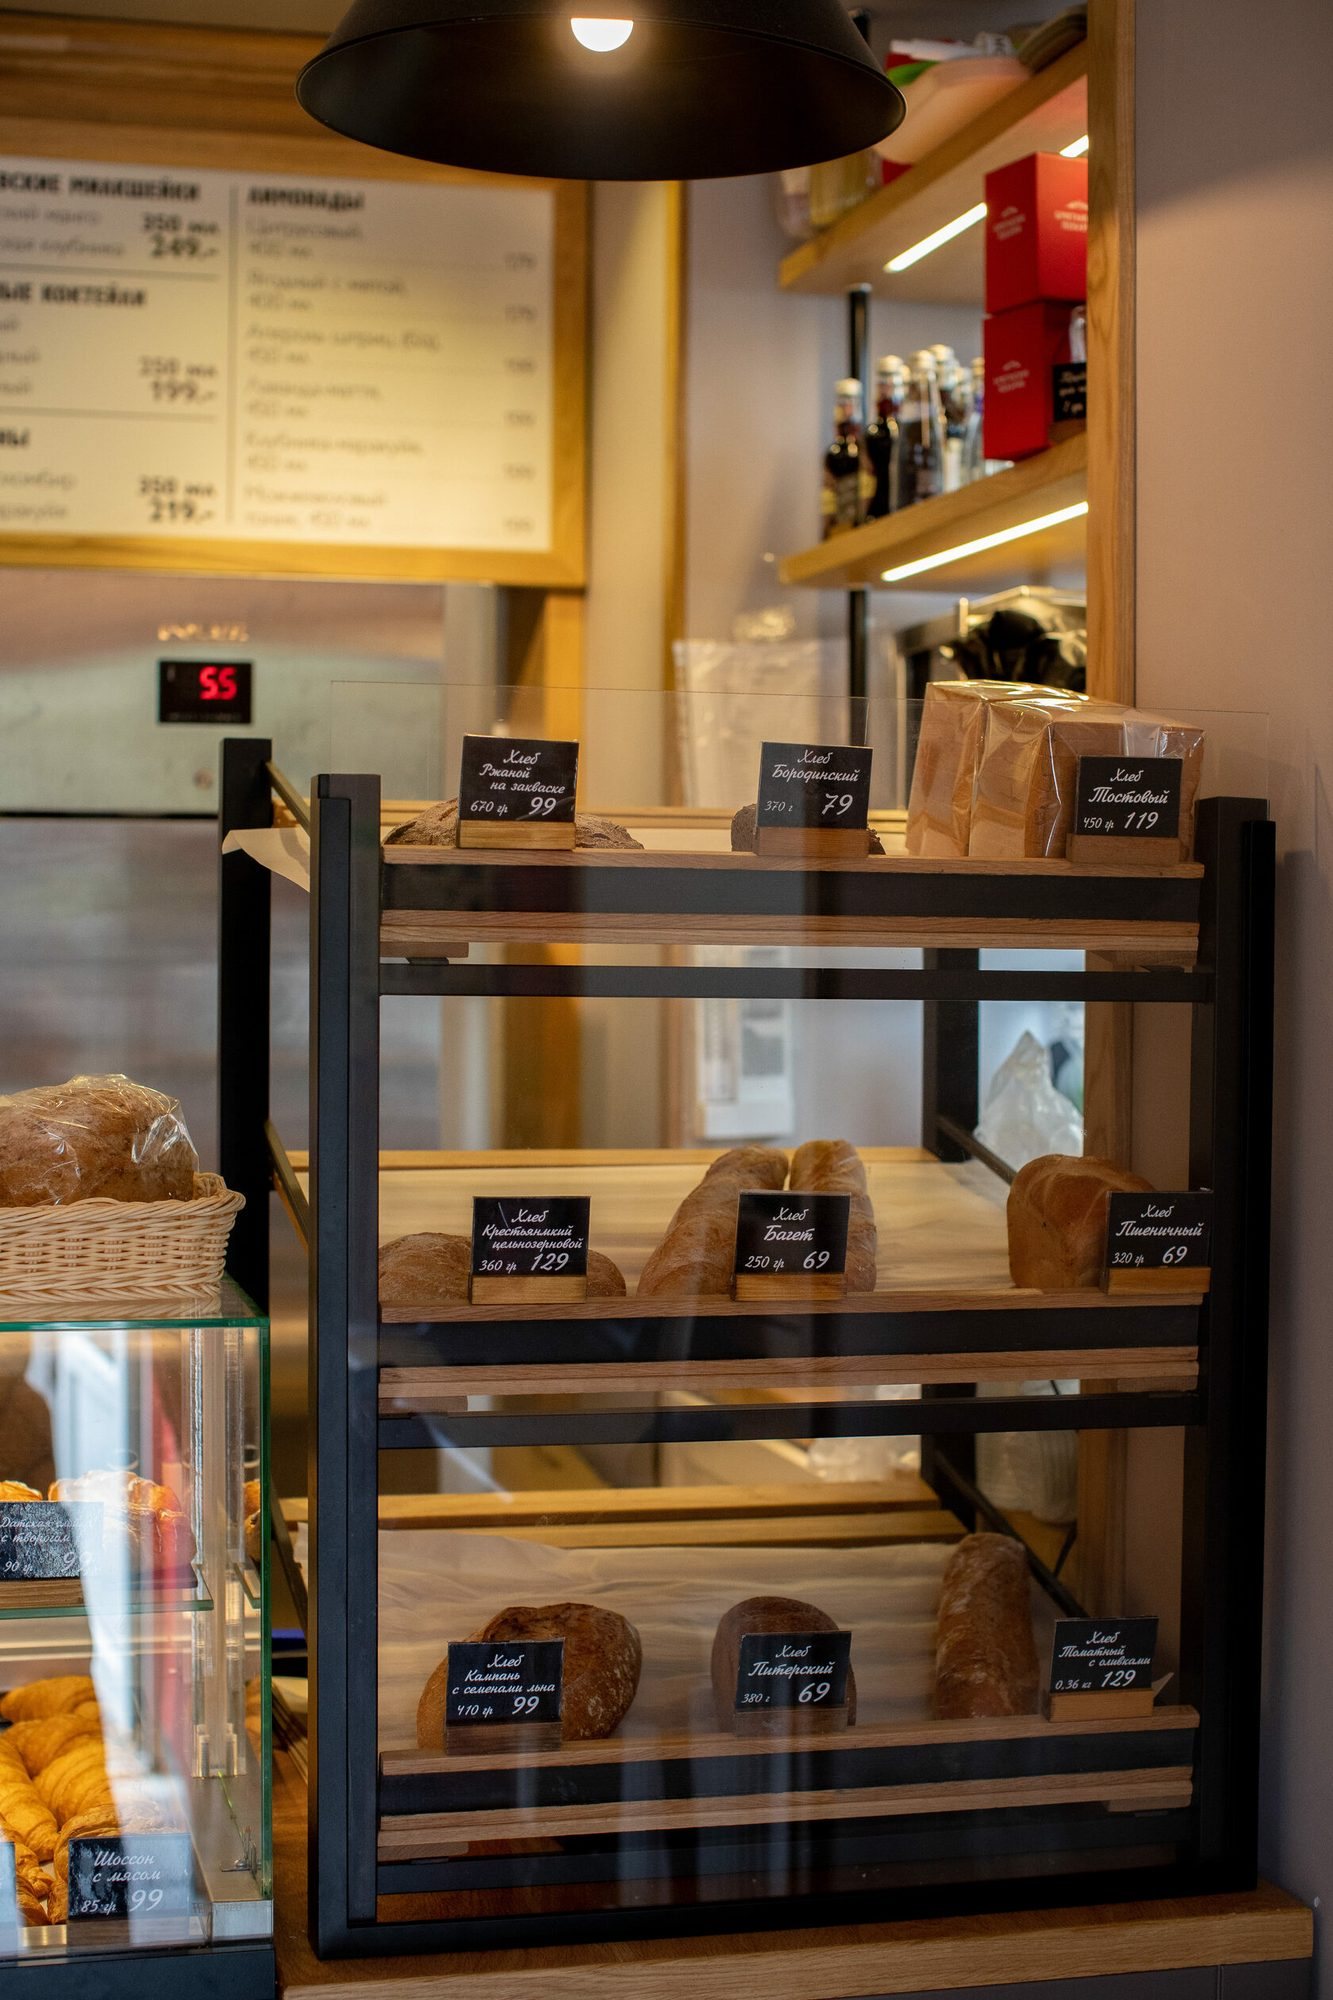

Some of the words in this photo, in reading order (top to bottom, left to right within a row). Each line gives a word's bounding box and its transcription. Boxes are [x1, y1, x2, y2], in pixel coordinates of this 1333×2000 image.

[503, 749, 541, 764] Хлеб
[797, 749, 834, 764] Хлеб
[479, 763, 532, 779] Ржаной
[772, 764, 860, 783] Бородинский
[1110, 768, 1144, 782] Хлеб
[490, 782, 506, 790] на
[510, 782, 565, 793] закваске
[1088, 786, 1170, 804] Тостовый
[470, 800, 494, 812] 670
[497, 804, 508, 817] гр
[528, 796, 557, 816] 99
[764, 800, 786, 812] 370
[821, 793, 853, 816] 79
[1083, 817, 1102, 829] 450
[1104, 820, 1114, 833] гр
[1124, 811, 1159, 830] 119
[511, 1208, 549, 1223] Хлеб
[772, 1207, 809, 1221] Хлеб
[1140, 1204, 1175, 1218] Хлеб
[763, 1224, 815, 1241] Багет
[1115, 1220, 1205, 1236] Пшеничный
[492, 1238, 584, 1252] цельнозерновой
[479, 1259, 503, 1271] 360
[505, 1262, 517, 1274] гр
[530, 1252, 569, 1271] 129
[745, 1255, 770, 1268] 250
[773, 1258, 785, 1272] гр
[803, 1250, 830, 1269] 69
[1111, 1252, 1132, 1264] 320
[1134, 1255, 1145, 1267] гр
[1162, 1246, 1188, 1264] 69
[4, 1560, 20, 1572] 90
[1086, 1631, 1121, 1645] Хлеб
[775, 1644, 812, 1658] Хлеб
[1058, 1645, 1127, 1658] Томатный
[487, 1653, 525, 1668] Хлеб
[1088, 1659, 1096, 1667] с
[1098, 1655, 1151, 1666] оливками
[464, 1669, 521, 1682] Кампань
[747, 1661, 836, 1680] Питерский
[1082, 1681, 1092, 1689] кг
[1101, 1669, 1137, 1688] 129
[452, 1687, 460, 1695] с
[463, 1684, 523, 1694] семенами
[526, 1683, 555, 1692] льна
[741, 1693, 763, 1703] 380
[798, 1681, 831, 1703] 69
[457, 1704, 479, 1716] 410
[482, 1706, 493, 1719] гр
[511, 1696, 540, 1715] 99
[94, 1850, 155, 1867] Шоссон
[92, 1873, 102, 1883] с
[107, 1871, 161, 1882] мясом
[80, 1899, 100, 1913] 85
[103, 1901, 117, 1915] гр
[129, 1889, 164, 1912] 99
